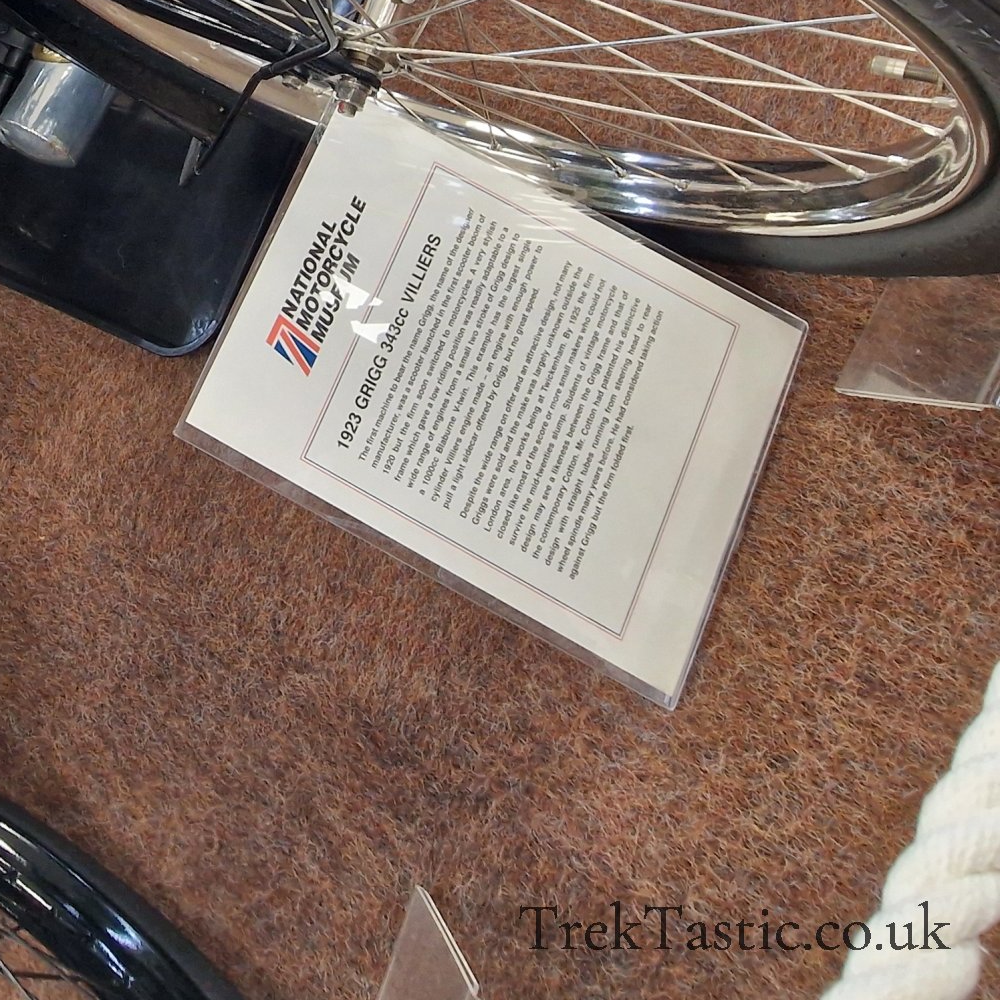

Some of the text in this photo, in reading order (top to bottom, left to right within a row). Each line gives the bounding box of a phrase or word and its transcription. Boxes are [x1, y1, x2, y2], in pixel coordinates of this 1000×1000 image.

[512, 233, 520, 241] to
[446, 256, 453, 265] of
[449, 244, 459, 256] the
[501, 243, 515, 269] design
[281, 221, 336, 319] NATIONAL
[296, 195, 366, 331] MOTORCYCLE
[436, 267, 449, 288] name
[490, 270, 505, 292] Grigg
[429, 289, 439, 301] the
[487, 292, 494, 302] of
[418, 304, 434, 326] Grigg,
[476, 303, 489, 328] stroke
[337, 234, 441, 448] 1923 GRIGG 343cc VILLIERS
[371, 413, 401, 468] manufacturer,
[397, 394, 407, 410] was
[408, 354, 424, 386] scooter
[420, 317, 441, 354] launched
[436, 309, 445, 317] in
[441, 294, 451, 307] the
[447, 277, 459, 293] first
[456, 246, 471, 276] scooter
[478, 213, 485, 223] of
[383, 454, 395, 473] 1920
[391, 437, 403, 452] but
[399, 422, 410, 435] the
[406, 402, 419, 419] firm
[416, 379, 428, 400] soon
[426, 339, 445, 376] switched
[442, 329, 450, 338] to
[448, 278, 473, 327] motorcycles.
[474, 248, 486, 265] very
[483, 221, 497, 246] stylish
[409, 328, 422, 349] name
[468, 330, 478, 345] two
[394, 457, 409, 481] frame
[406, 431, 420, 455] which
[418, 409, 430, 430] gave
[429, 386, 439, 401] low
[437, 361, 452, 385] riding
[448, 327, 465, 360] position
[462, 310, 473, 325] was
[470, 281, 486, 308] readily
[482, 243, 501, 280] adaptable
[498, 233, 505, 242] to
[402, 350, 412, 363] the
[459, 346, 471, 368] small
[393, 363, 405, 382] bear
[422, 457, 439, 484] 1000cc
[452, 387, 469, 412] V-twin.
[465, 365, 478, 381] This
[476, 328, 493, 361] example
[490, 311, 501, 326] has
[498, 295, 507, 308] the
[504, 265, 520, 292] largest
[430, 467, 448, 501] cylinder
[444, 437, 462, 464] Villiers
[459, 407, 474, 435] engine
[472, 382, 485, 405] made
[486, 362, 494, 372] an
[491, 332, 506, 359] engine
[503, 314, 514, 330] with
[512, 282, 527, 311] enough
[525, 255, 538, 280] power
[534, 245, 542, 253] to
[389, 383, 398, 392] to
[445, 377, 458, 396] from
[443, 491, 453, 509] pull
[452, 464, 465, 483] light
[462, 432, 478, 463] sidecar
[476, 400, 491, 430] offered
[487, 389, 497, 400] by
[492, 365, 508, 388] Grigg,
[503, 347, 514, 362] but
[511, 336, 519, 347] no
[516, 313, 528, 335] great
[525, 288, 539, 313] speed.
[375, 393, 393, 427] machine
[432, 398, 449, 430] engines
[366, 428, 378, 445] first
[428, 431, 435, 441] of
[358, 445, 370, 460] The
[416, 442, 430, 466] range
[407, 468, 419, 487] wide
